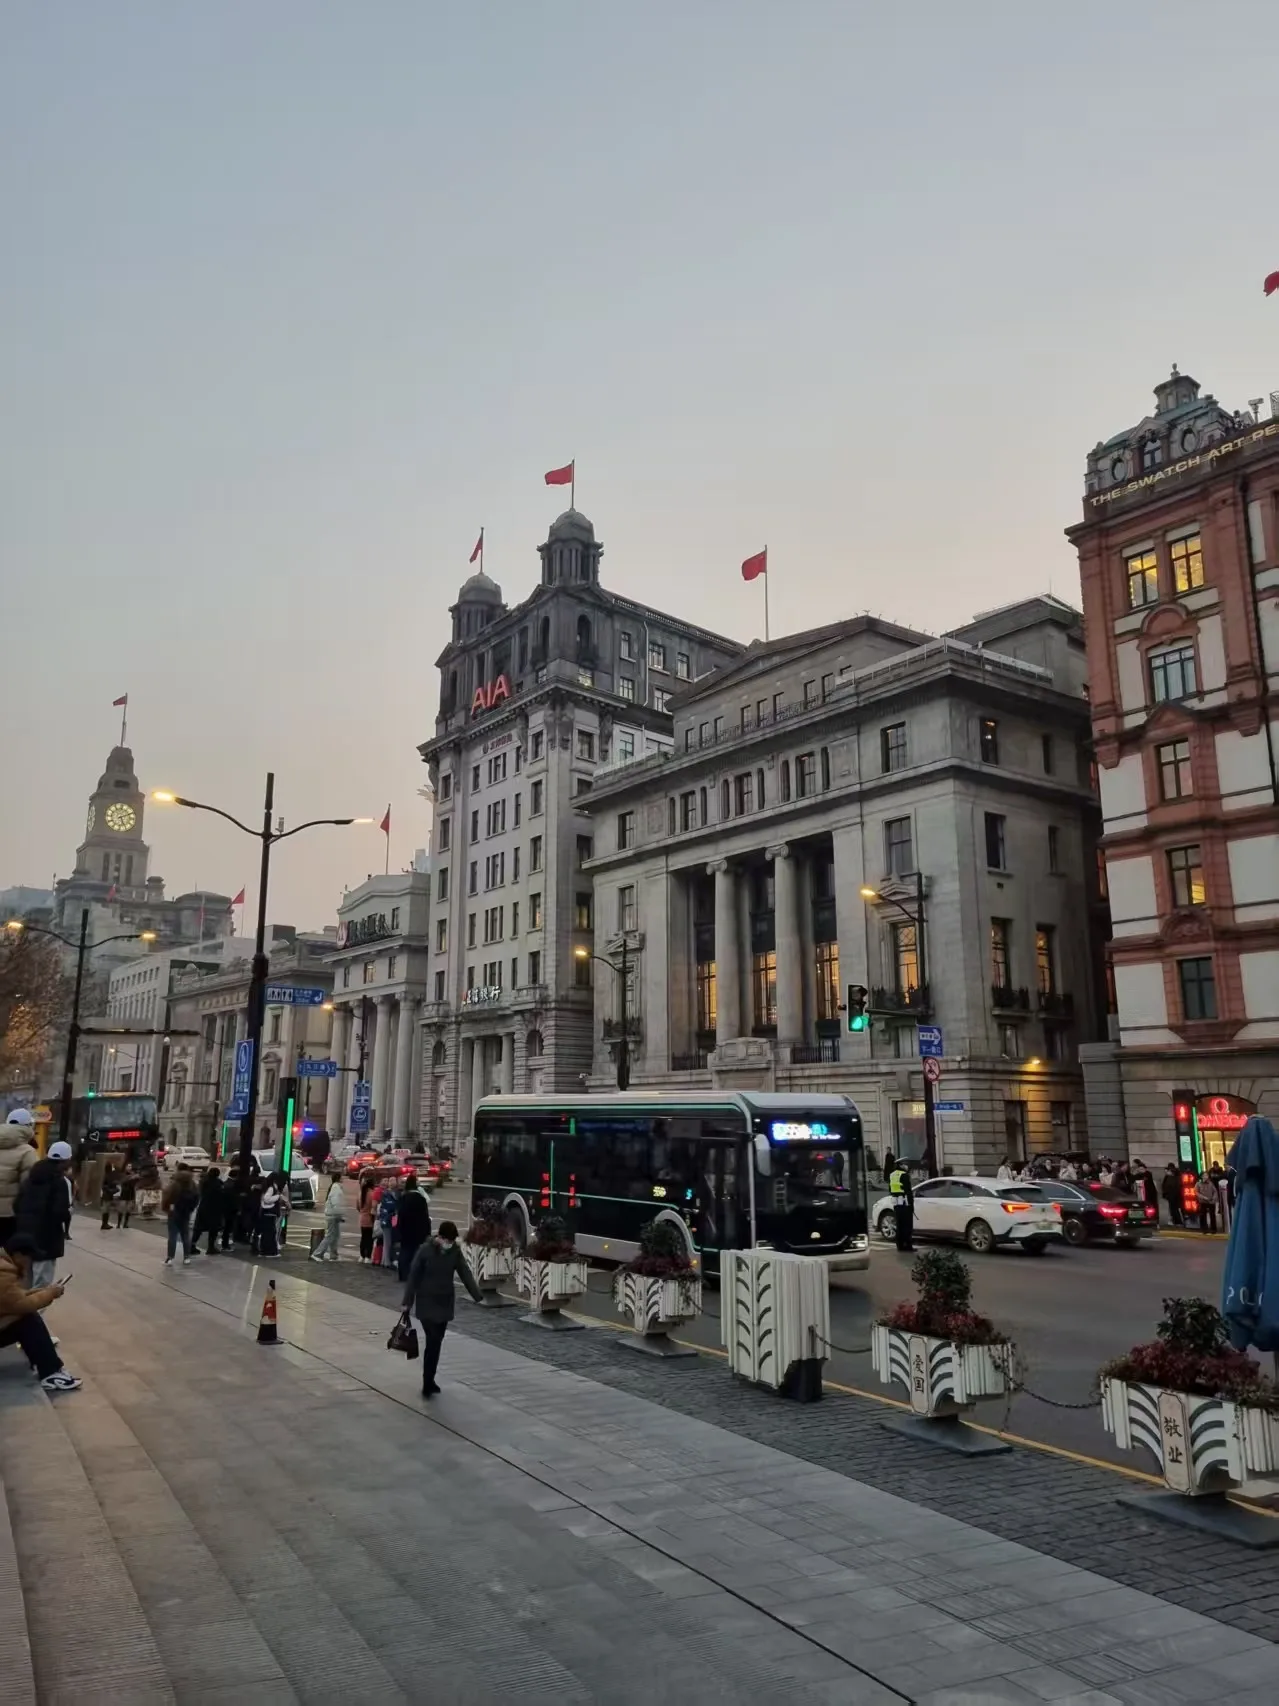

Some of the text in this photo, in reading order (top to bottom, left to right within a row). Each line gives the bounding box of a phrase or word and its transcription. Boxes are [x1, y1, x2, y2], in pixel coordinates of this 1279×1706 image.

[1090, 424, 1279, 507] THE SWATCH ART PE
[470, 674, 511, 715] AIA
[1197, 1113, 1248, 1128] OMEGA
[913, 1354, 924, 1393] 爱国
[1163, 1417, 1183, 1464] 敬业
